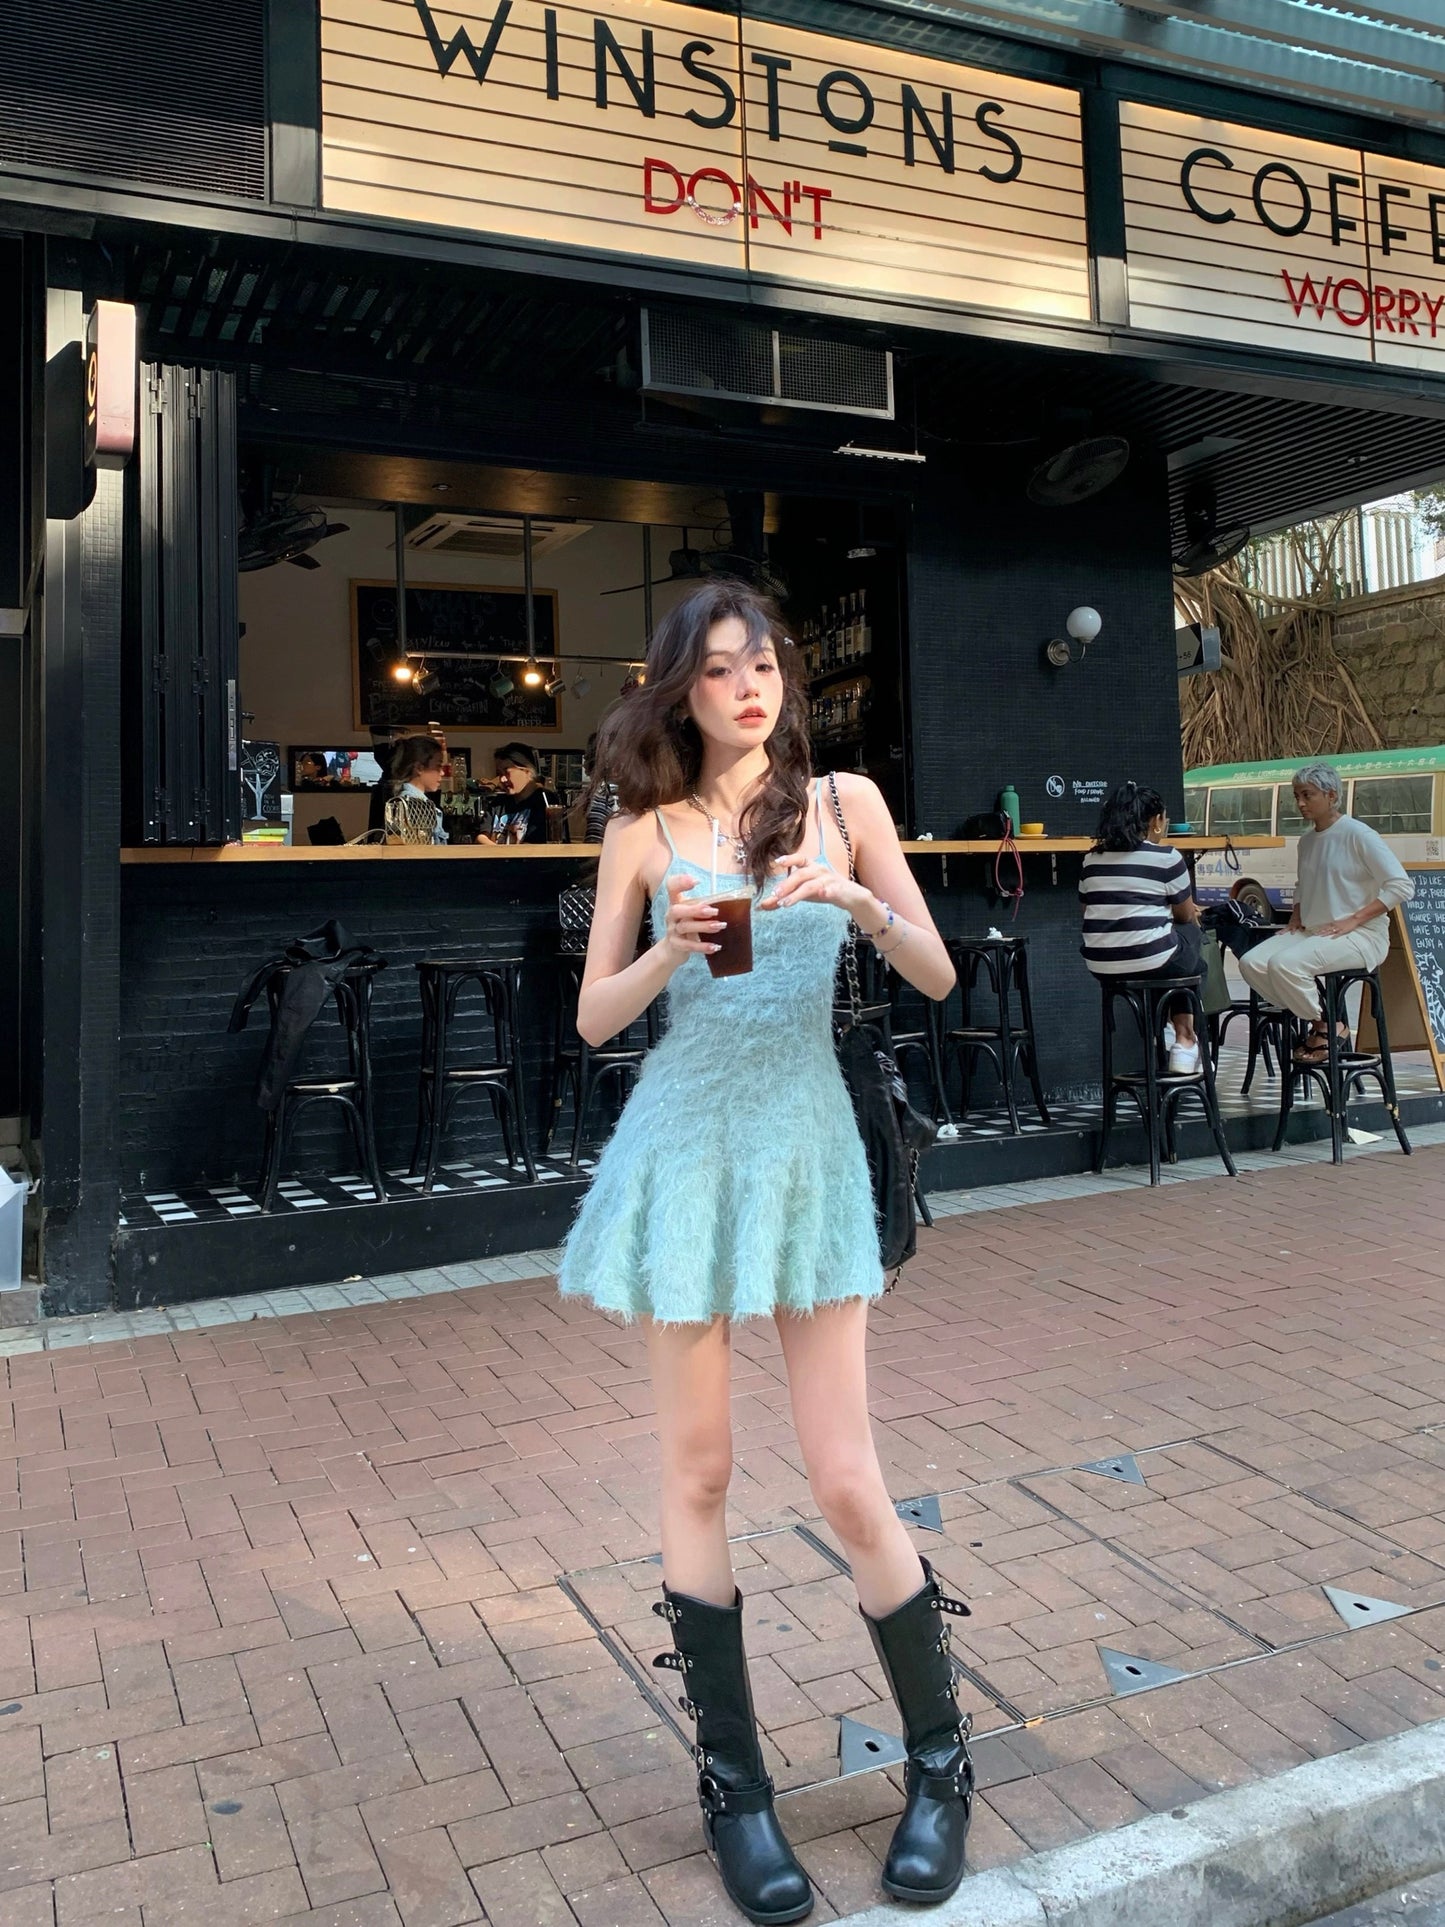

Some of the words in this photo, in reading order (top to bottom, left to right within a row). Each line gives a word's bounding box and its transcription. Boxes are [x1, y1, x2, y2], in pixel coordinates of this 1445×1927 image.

[412, 0, 1023, 184] WINSTONS
[643, 157, 832, 240] DON'T
[1281, 269, 1445, 338] WORRY
[1428, 876, 1442, 886] LIKE
[1408, 912, 1432, 923] IGNORE
[1412, 925, 1431, 936] HAVE
[1415, 938, 1435, 949] ENJOY
[1438, 939, 1444, 949] A
